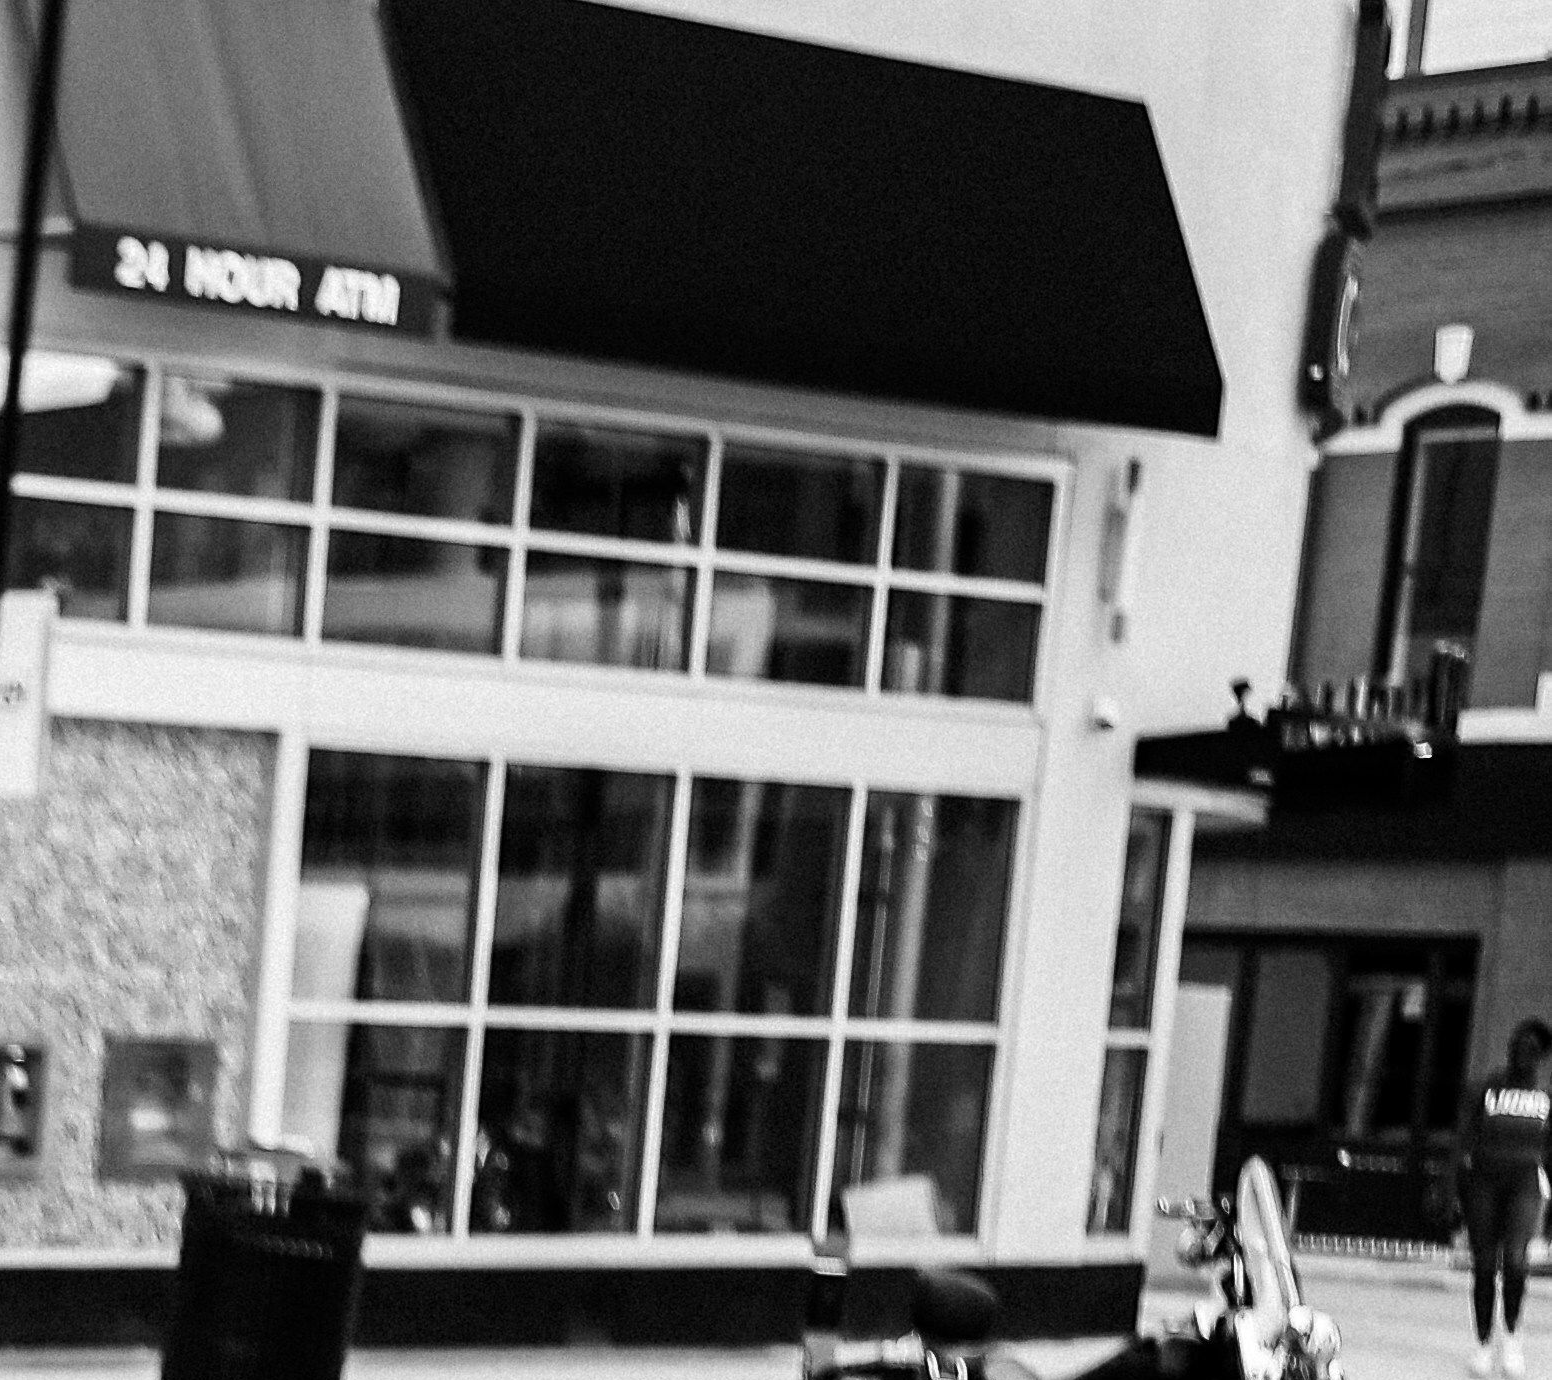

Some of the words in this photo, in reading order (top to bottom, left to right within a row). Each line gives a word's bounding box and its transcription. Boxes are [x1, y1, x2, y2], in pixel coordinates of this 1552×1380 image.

[113, 235, 171, 293] 24
[183, 244, 302, 313] HOUR
[314, 265, 401, 327] ATM
